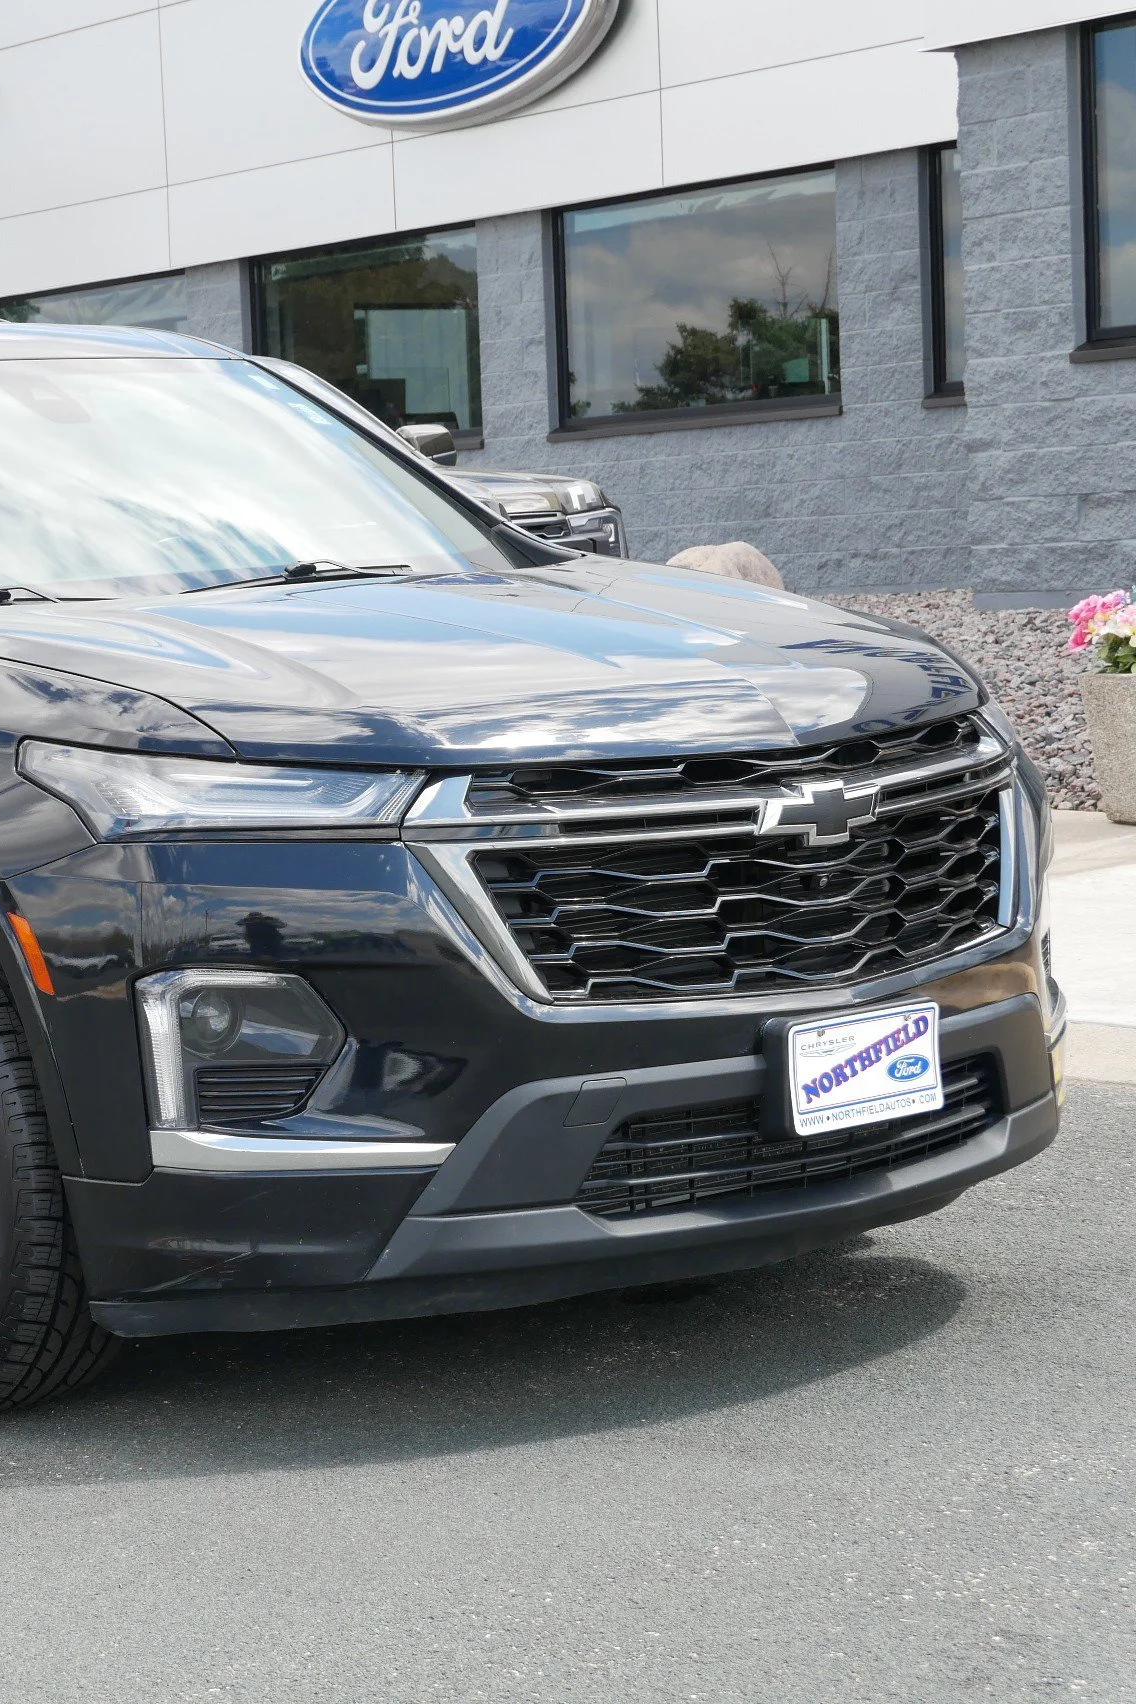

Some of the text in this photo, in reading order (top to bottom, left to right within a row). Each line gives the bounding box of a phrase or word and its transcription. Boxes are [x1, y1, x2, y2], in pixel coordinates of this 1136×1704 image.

[350, 0, 513, 90] Ford
[800, 1035, 855, 1051] CHRYSLER
[801, 1014, 929, 1104] NORTHFIELD
[894, 1058, 922, 1078] Ford
